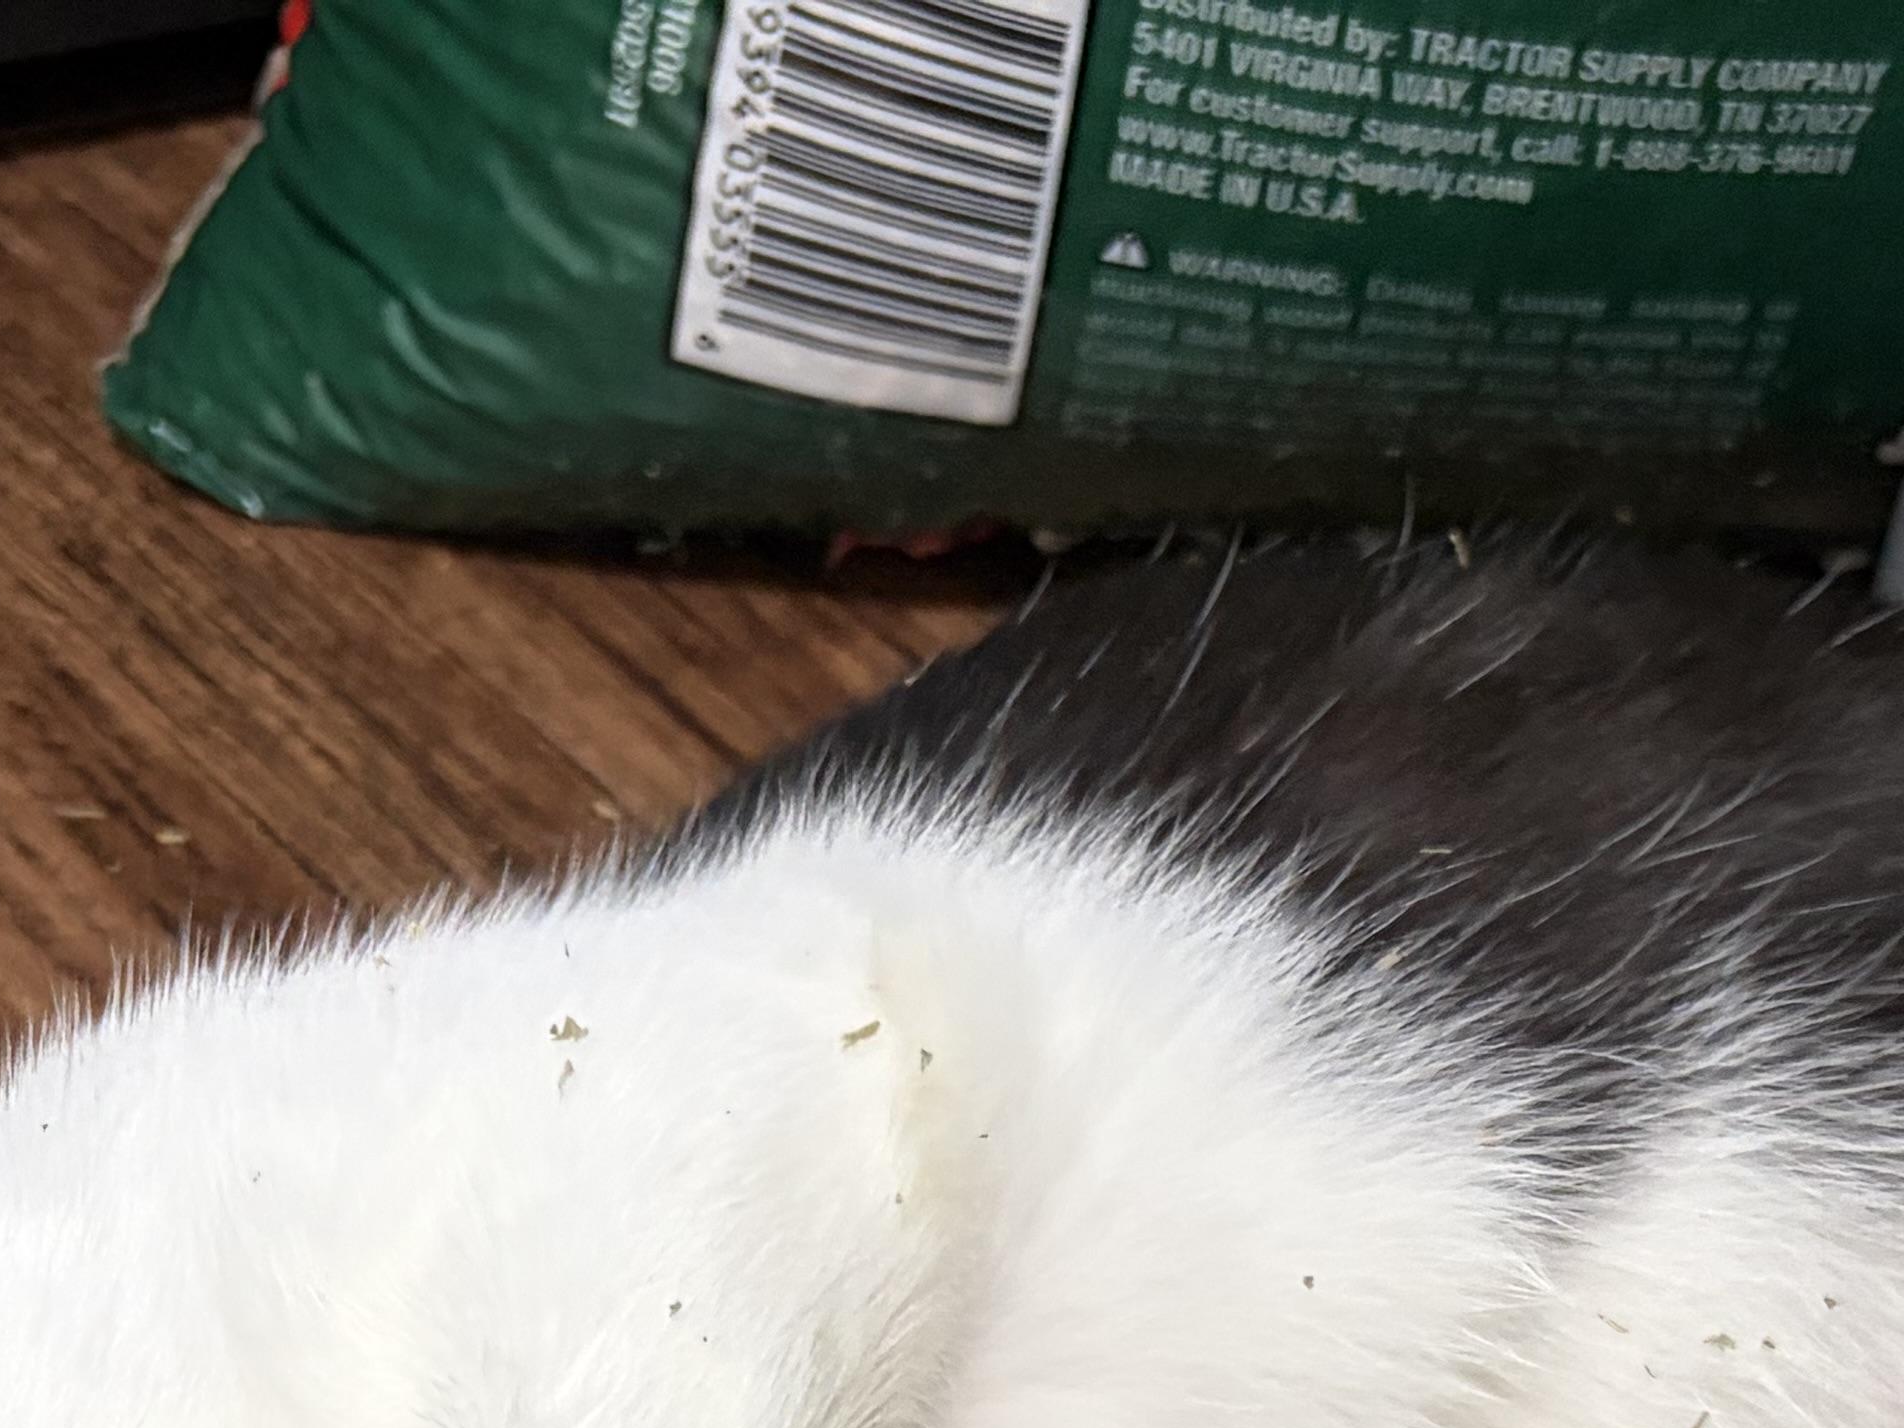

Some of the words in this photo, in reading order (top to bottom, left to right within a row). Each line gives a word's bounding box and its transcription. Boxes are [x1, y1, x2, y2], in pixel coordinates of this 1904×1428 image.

[1131, 20, 1218, 68] 5401
[1229, 42, 1383, 100] VIRGINIA
[1717, 101, 1764, 132] TN
[1766, 103, 1874, 134] 37027
[1344, 18, 1397, 62] by:
[1409, 27, 1574, 80] TRACTOR
[1578, 49, 1714, 89] SUPPLY
[1716, 60, 1890, 95] COMPANY
[1117, 114, 1534, 204] www.TractorSupply.com
[1123, 64, 1186, 107] For
[1188, 86, 1358, 140] customer
[1359, 117, 1501, 166] support,
[1109, 150, 1216, 199] MADE
[1219, 172, 1262, 208] IN
